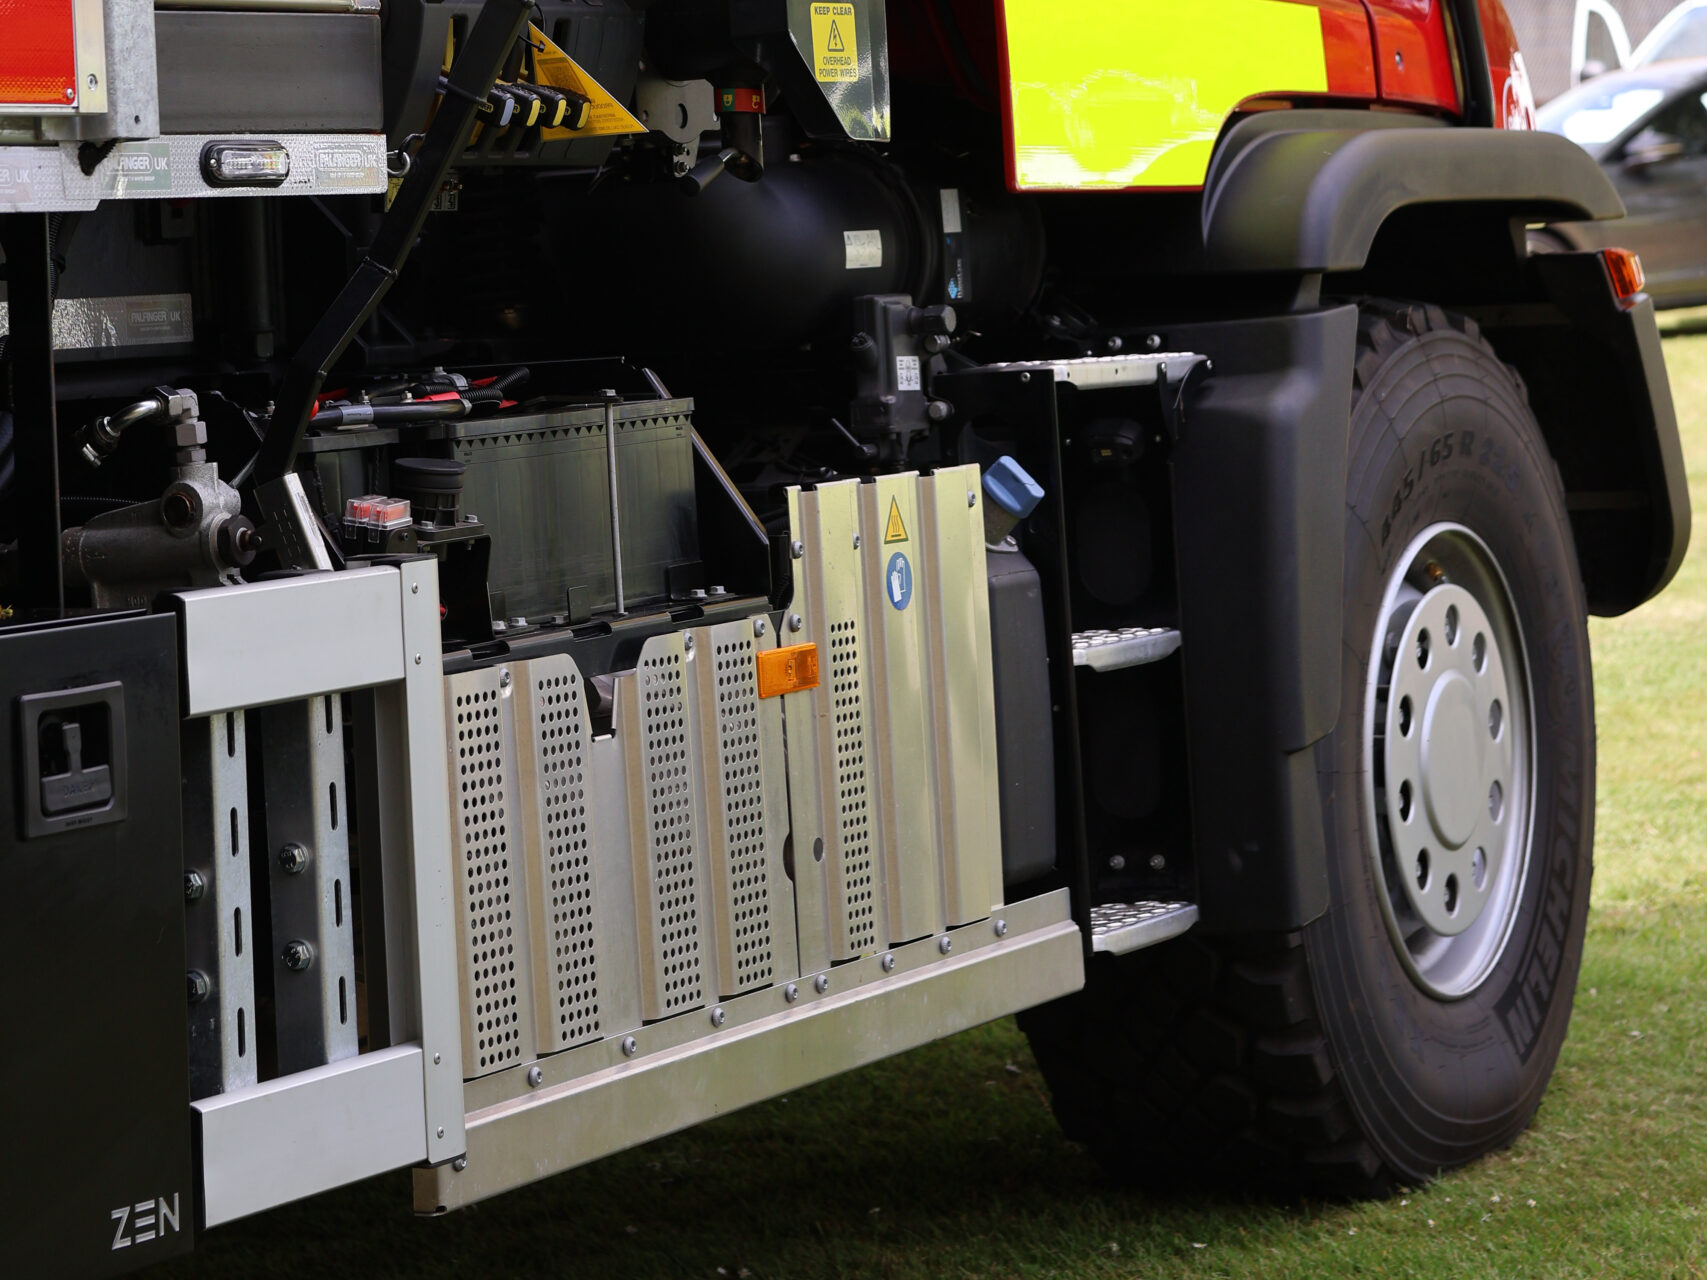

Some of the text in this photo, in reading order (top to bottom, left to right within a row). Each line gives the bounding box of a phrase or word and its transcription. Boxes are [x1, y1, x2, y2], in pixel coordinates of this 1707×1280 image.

[814, 6, 853, 16] KEEP CLEAR
[823, 56, 851, 65] OVERHEAD
[818, 68, 839, 77] POWER
[154, 157, 168, 170] UK
[319, 153, 361, 168] PALFINGER
[15, 168, 31, 183] UK
[131, 311, 181, 323] PALFINGER UK
[111, 1192, 180, 1250] ZEN
